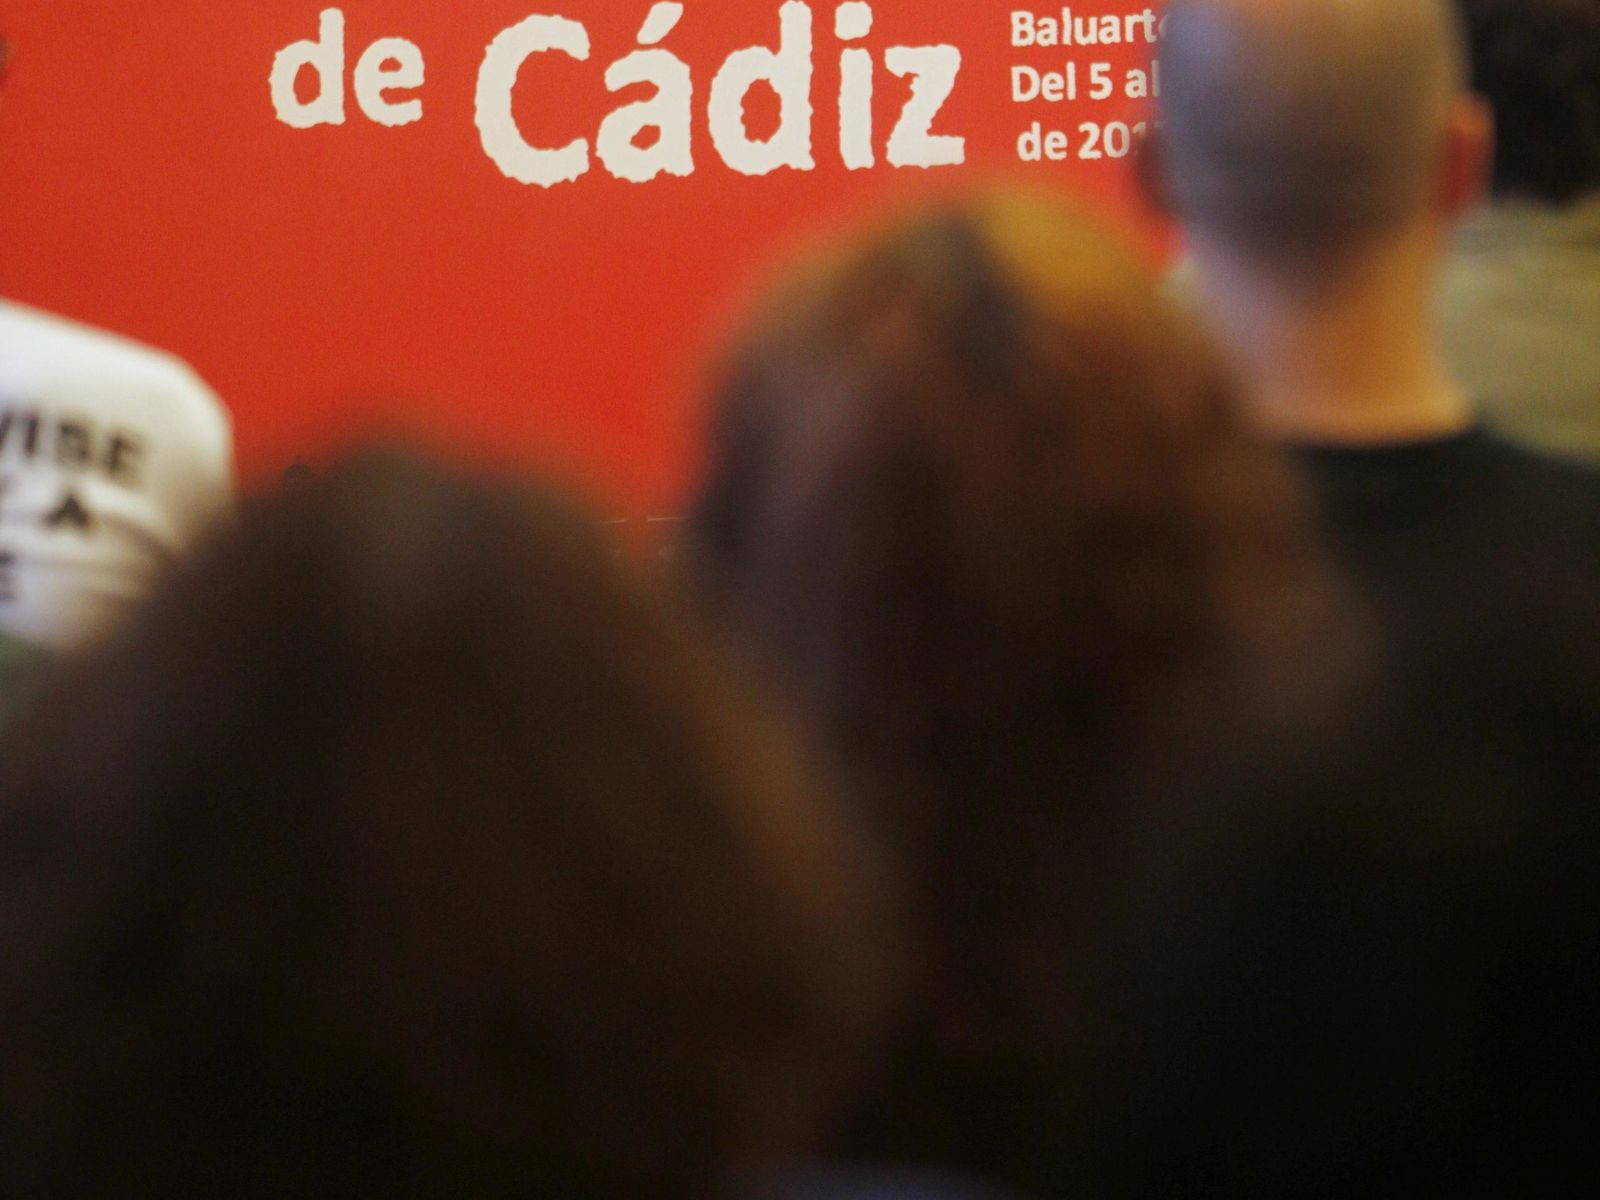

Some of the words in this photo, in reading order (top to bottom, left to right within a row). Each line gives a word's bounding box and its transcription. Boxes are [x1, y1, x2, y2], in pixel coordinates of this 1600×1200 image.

[268, 7, 425, 129] de
[474, 0, 966, 189] Cádiz
[1010, 61, 1077, 103] Del
[1089, 62, 1113, 100] 5
[1124, 59, 1161, 99] al
[1017, 121, 1068, 161] de
